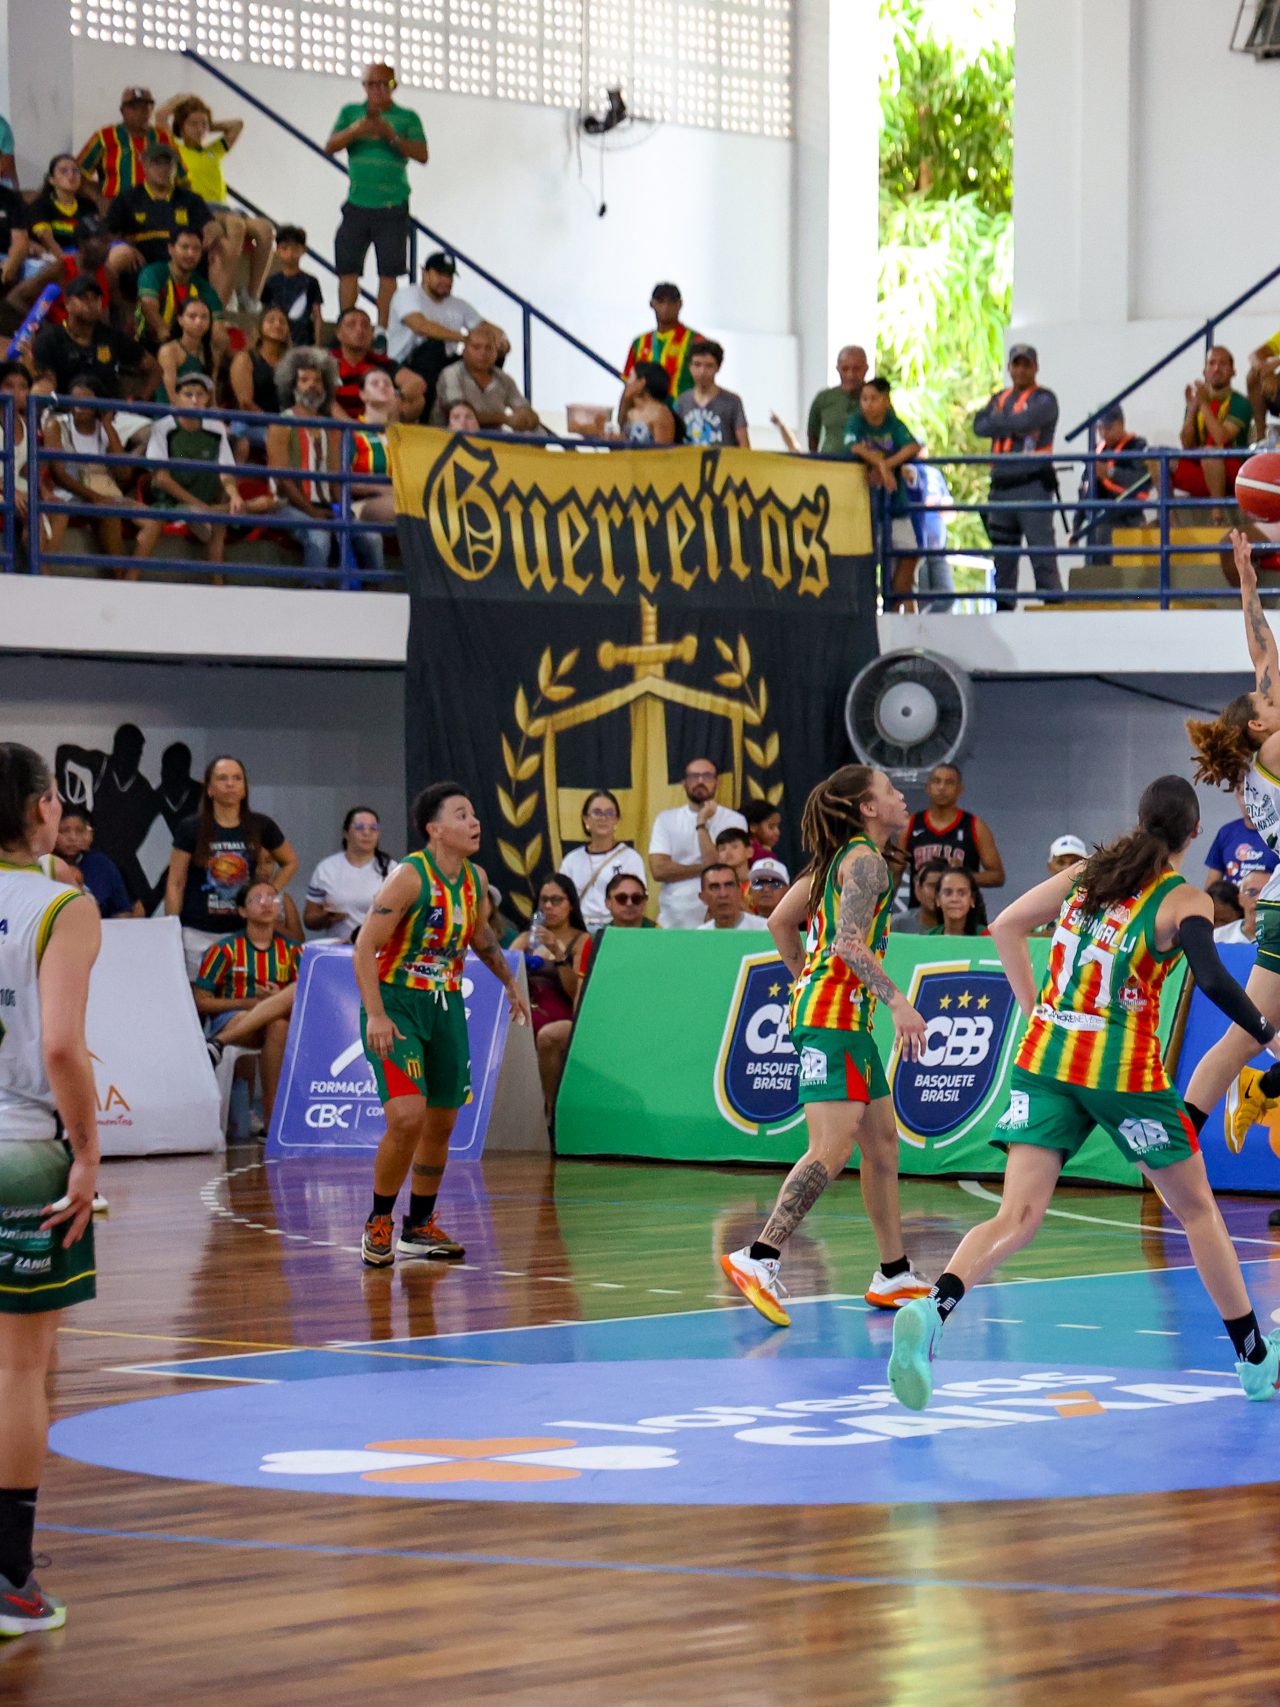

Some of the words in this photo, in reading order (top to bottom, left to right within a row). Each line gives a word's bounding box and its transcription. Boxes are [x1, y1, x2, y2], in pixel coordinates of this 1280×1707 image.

[424, 440, 831, 600] Guerreiros
[917, 1016, 994, 1067] CBB
[746, 1062, 799, 1079] BASQUET
[310, 1080, 378, 1097] FORMAÇÃ
[752, 1077, 792, 1091] BRASIL
[914, 1074, 975, 1091] BASQUETE
[920, 1089, 960, 1103] BRASIL
[304, 1103, 353, 1129] CBC
[733, 1382, 1249, 1447] CAIXA
